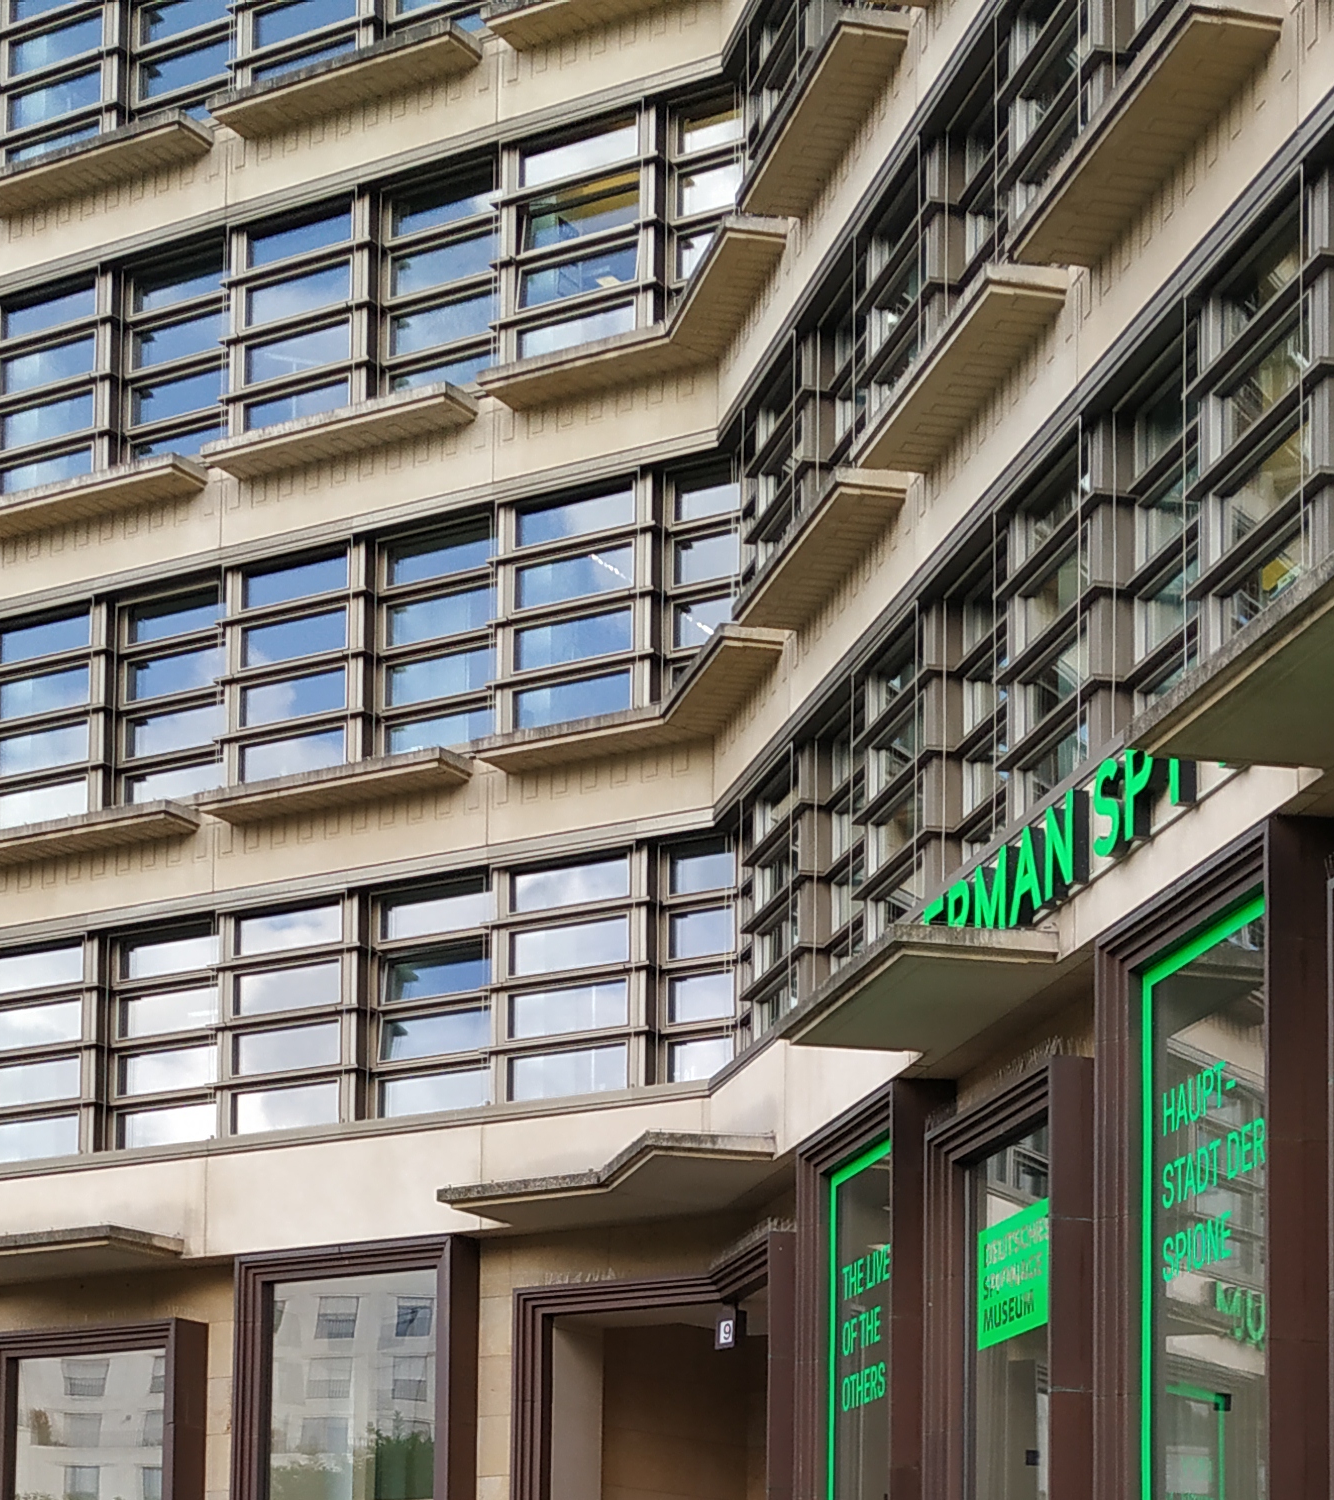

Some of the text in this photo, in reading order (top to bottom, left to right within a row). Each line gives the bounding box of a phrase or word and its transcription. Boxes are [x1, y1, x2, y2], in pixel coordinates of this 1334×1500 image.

[1163, 1061, 1236, 1136] HAUPT-
[1162, 1118, 1265, 1209] STADT DER
[1162, 1210, 1232, 1282] SPIONE
[842, 1258, 864, 1300] THE
[723, 1322, 732, 1341] 9
[842, 1306, 881, 1357] OF THE
[983, 1289, 1034, 1333] MUSEUM
[842, 1362, 886, 1412] OTHERS
